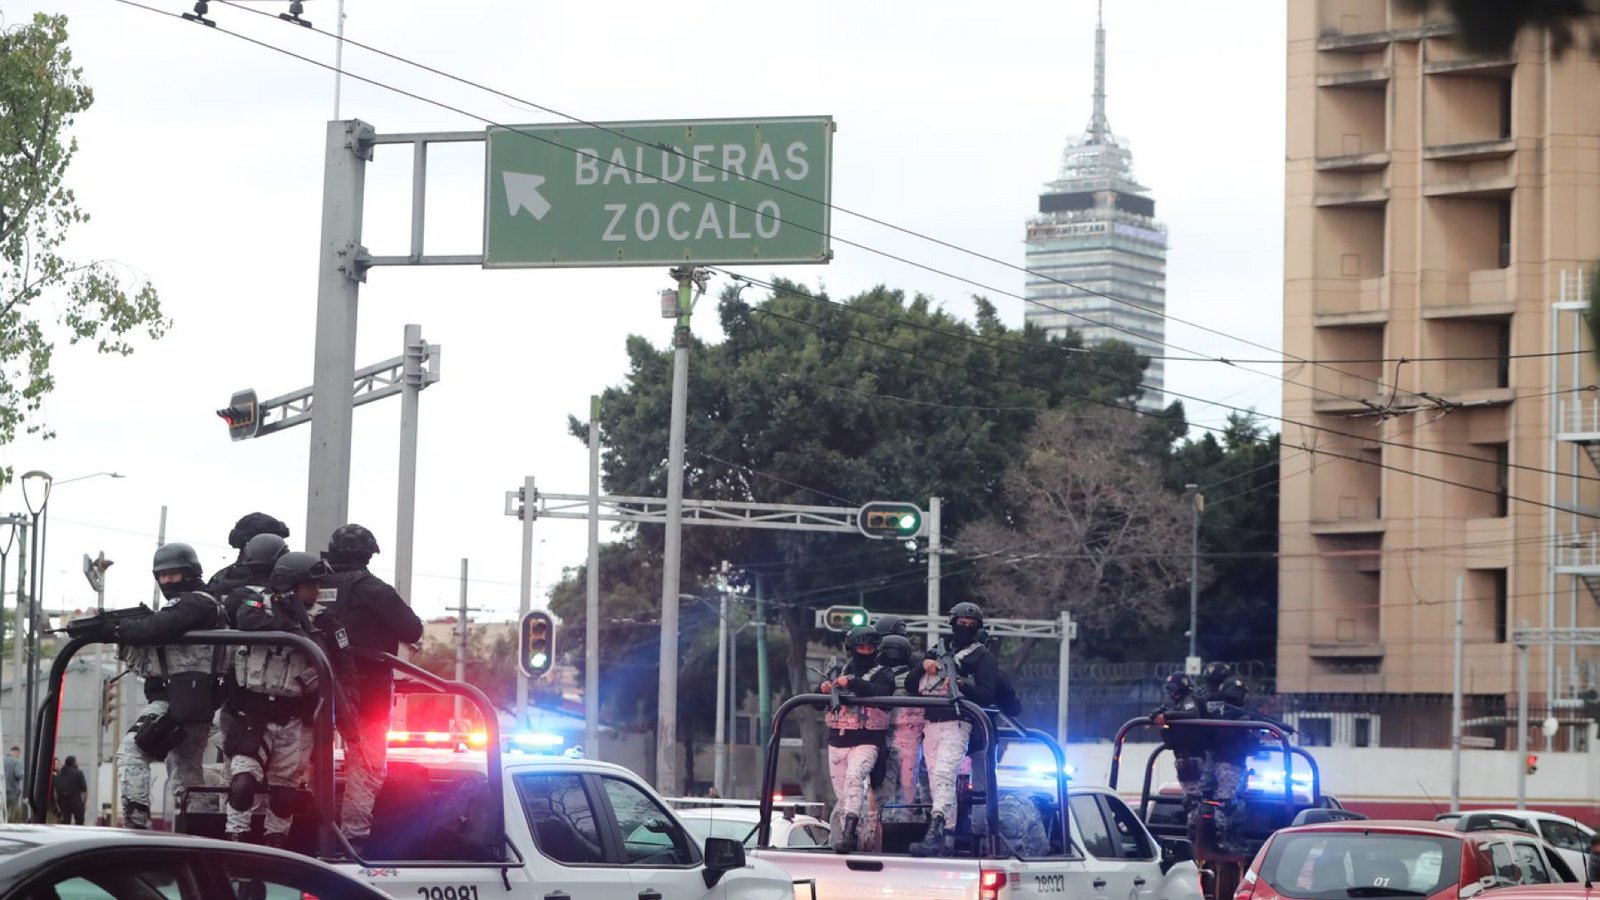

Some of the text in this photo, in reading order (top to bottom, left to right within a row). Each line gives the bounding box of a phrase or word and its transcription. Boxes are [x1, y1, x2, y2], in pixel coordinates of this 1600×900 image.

[576, 142, 809, 185] BALDERAS
[602, 200, 781, 241] ZOCALO
[1373, 877, 1390, 887] 01
